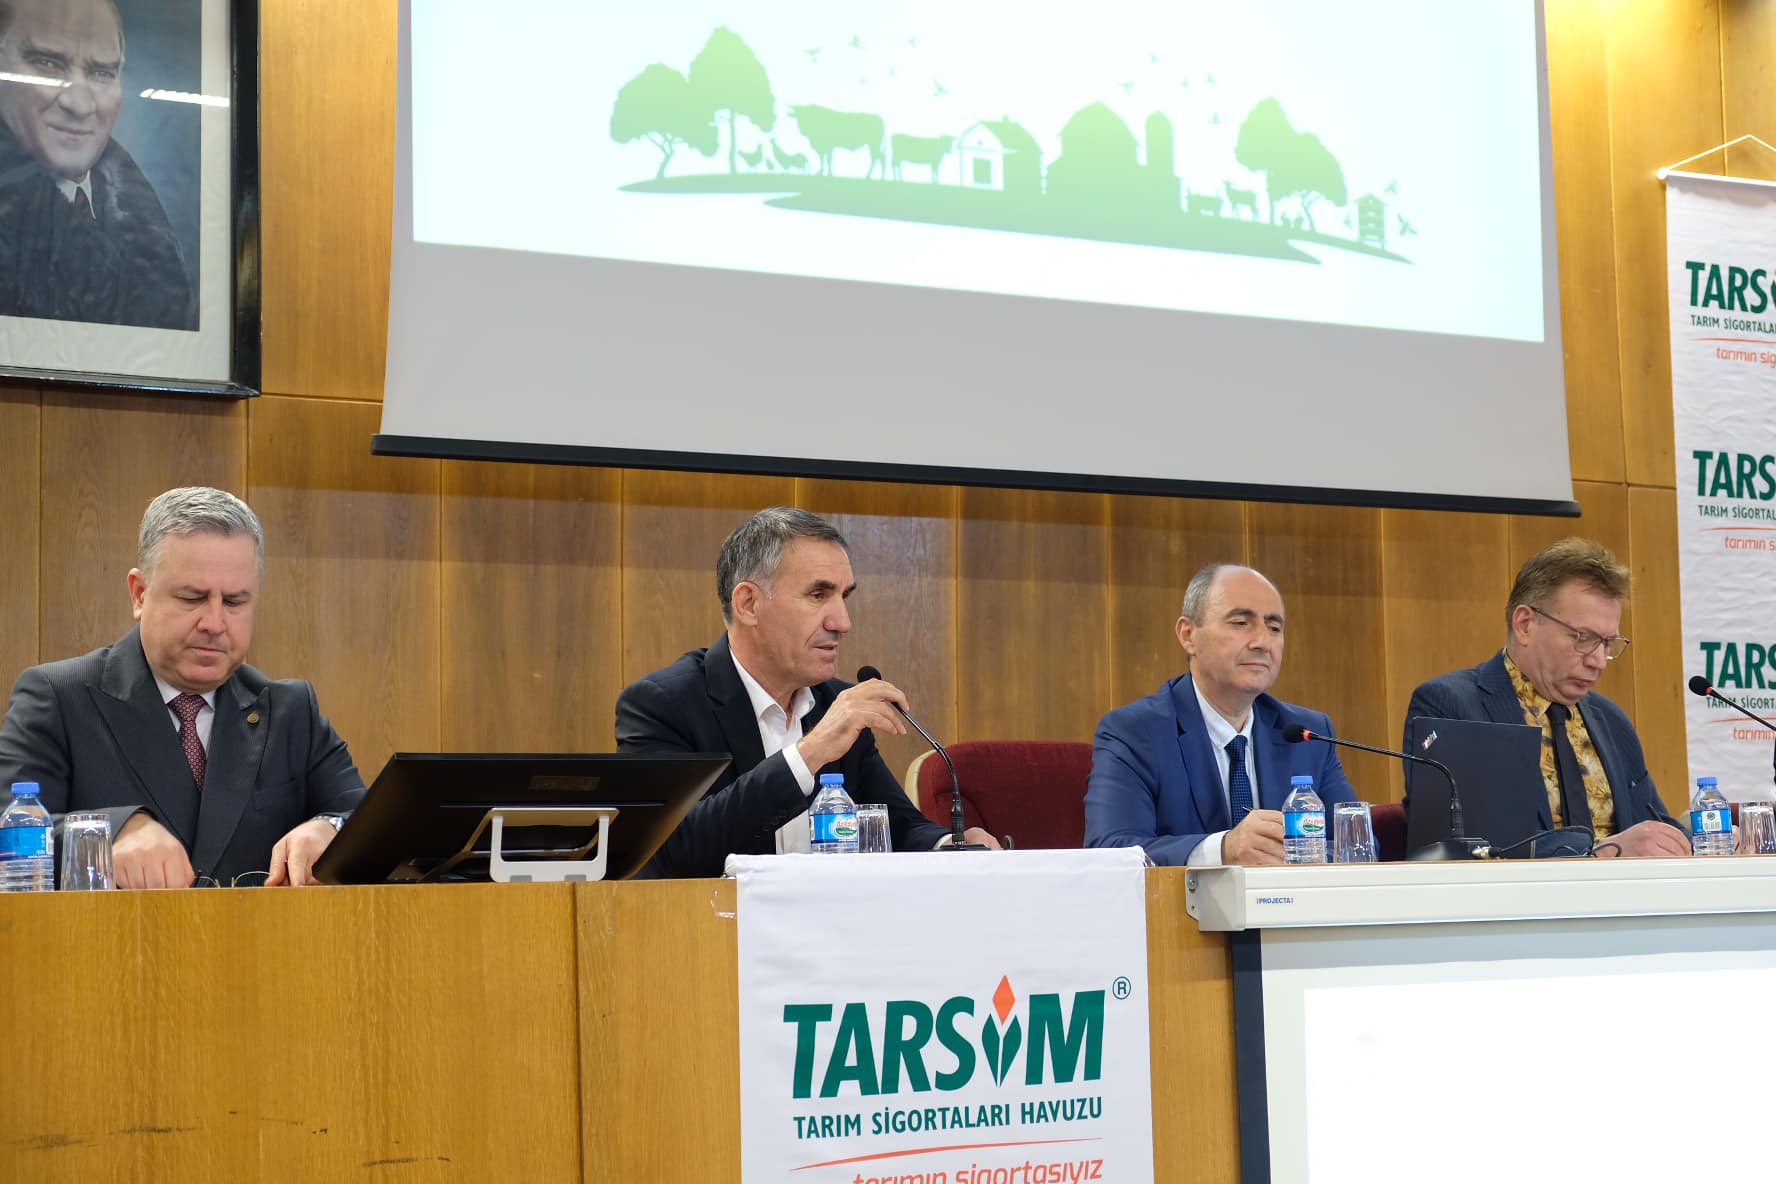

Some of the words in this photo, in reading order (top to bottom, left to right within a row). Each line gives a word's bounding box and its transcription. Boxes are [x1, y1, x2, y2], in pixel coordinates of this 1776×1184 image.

[1723, 316, 1776, 334] SİGORTALA
[793, 1113, 861, 1139] TARIM
[872, 1103, 1010, 1135] SİGORTALARI
[1021, 1096, 1102, 1125] HAVUZU
